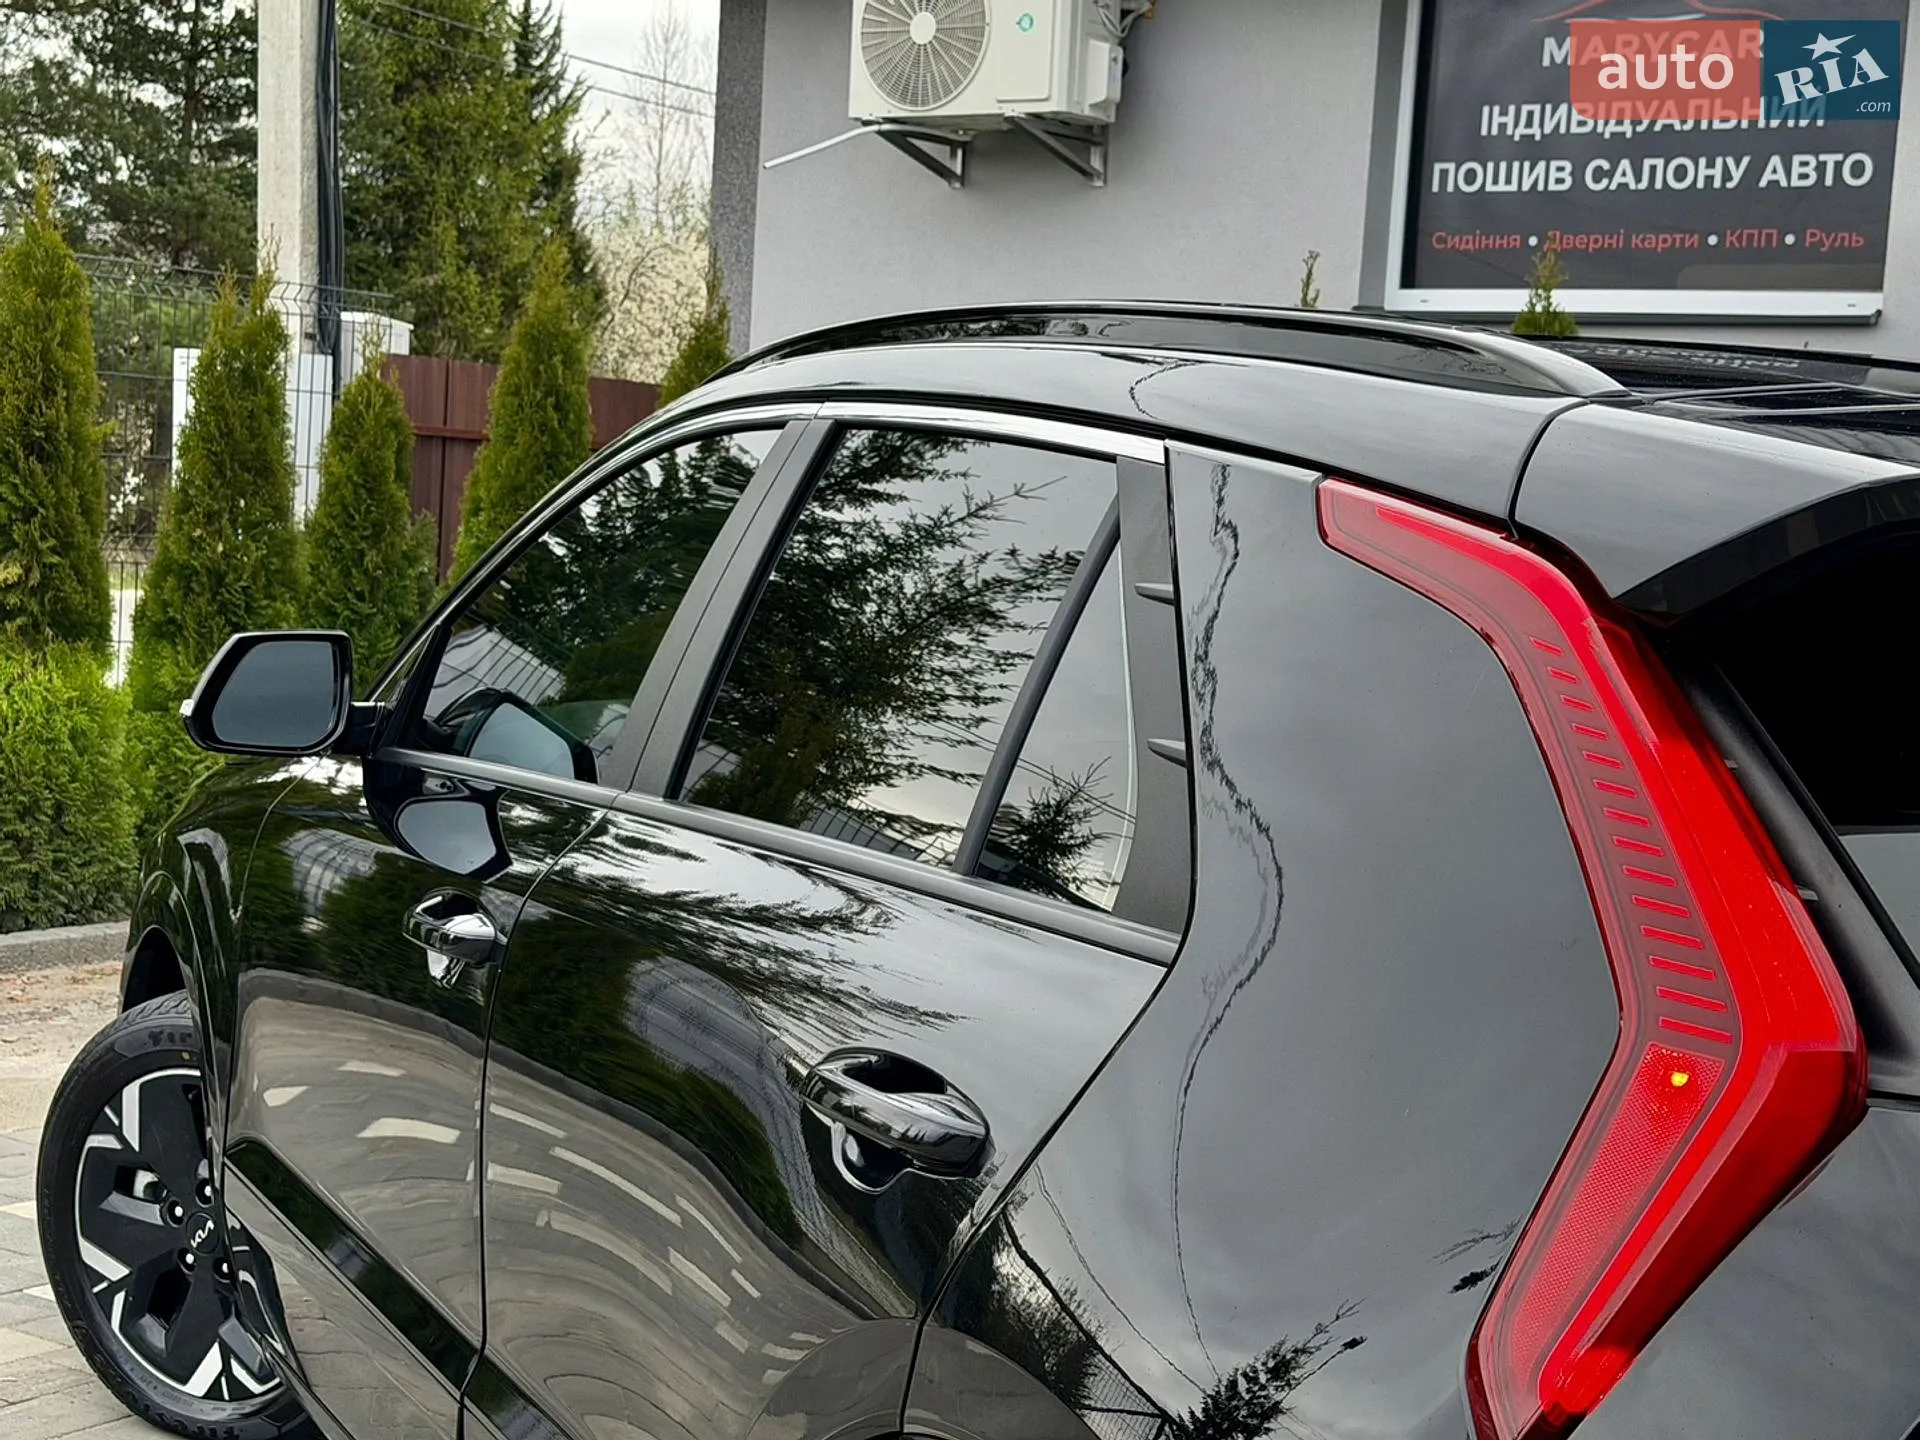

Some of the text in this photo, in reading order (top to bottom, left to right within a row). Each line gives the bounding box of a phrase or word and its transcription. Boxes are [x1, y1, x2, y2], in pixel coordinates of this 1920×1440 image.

[1431, 152, 1873, 193] ПОШИВ САЛОНУ АВТО
[1431, 228, 1865, 254] Сидіння Дверні карти КПП Руль
